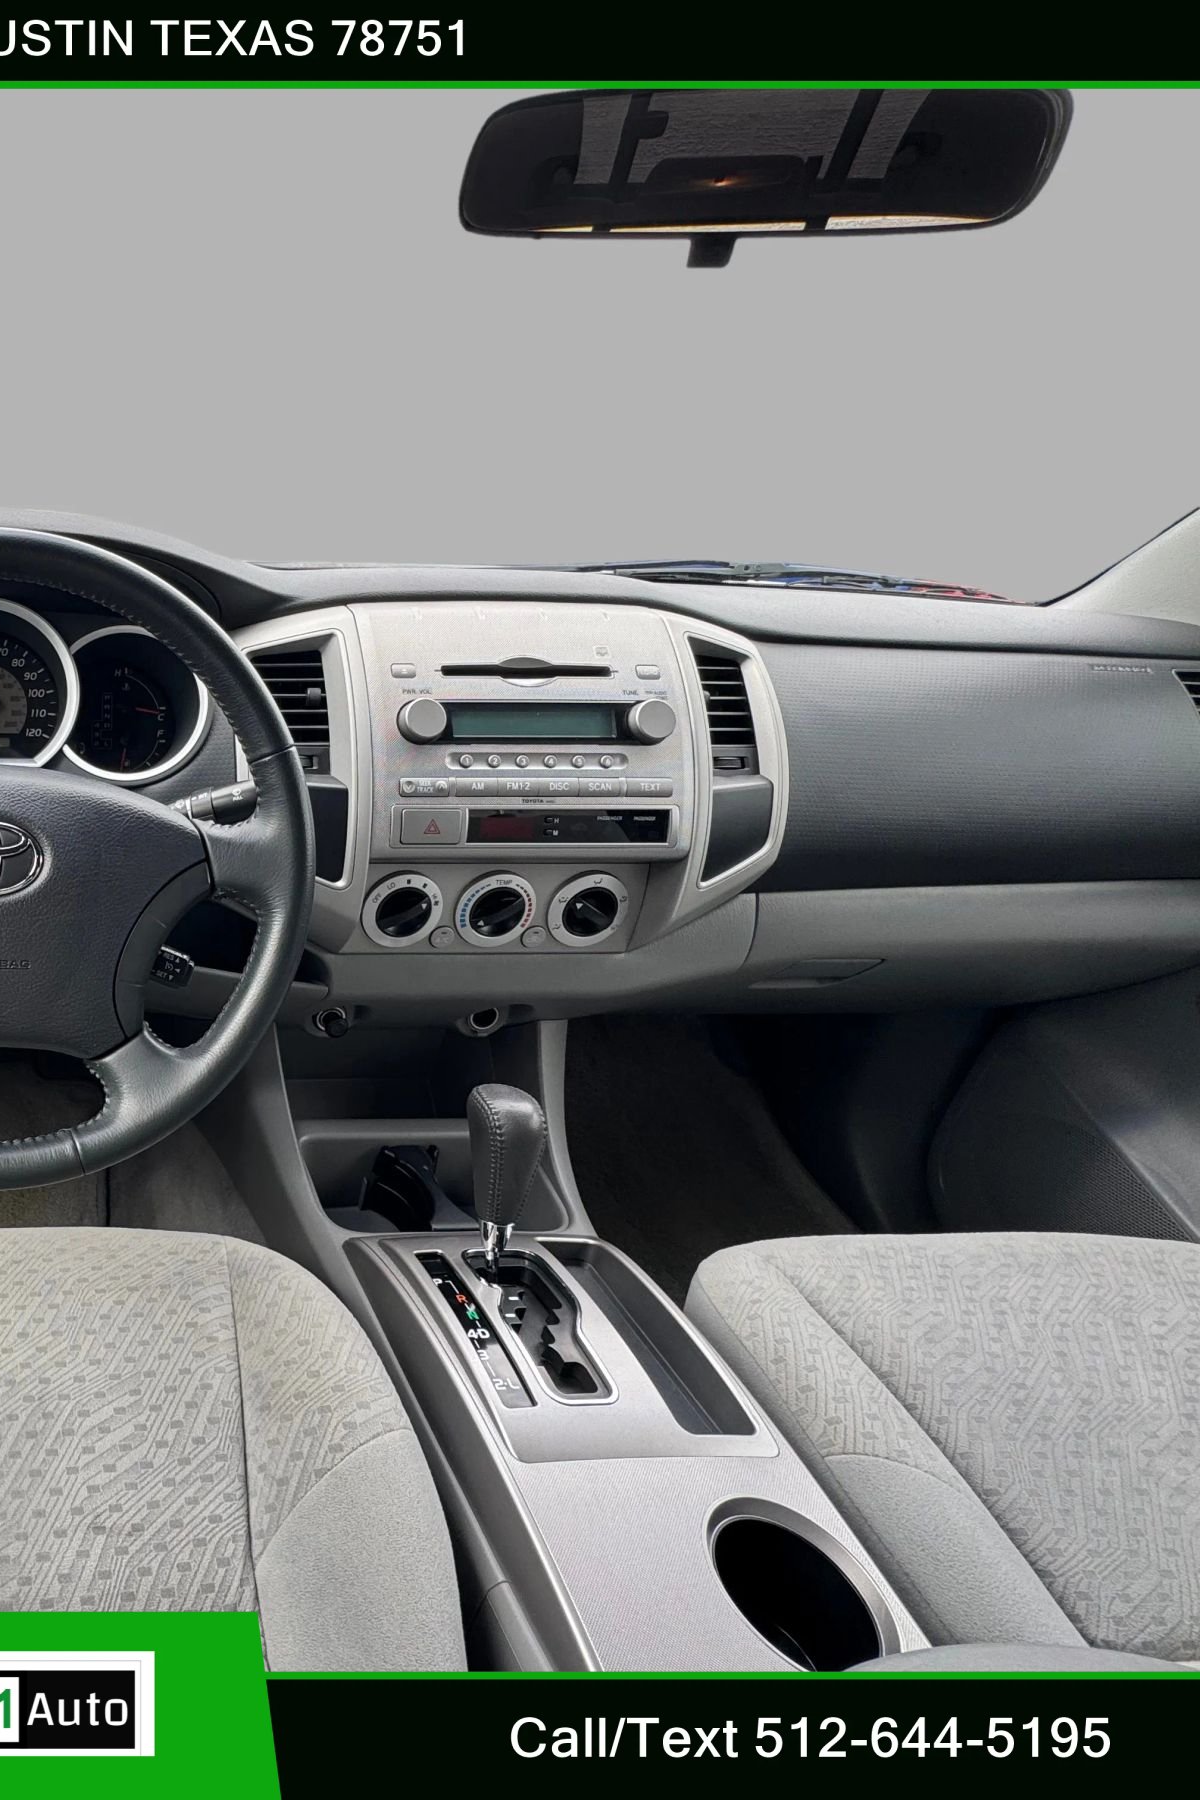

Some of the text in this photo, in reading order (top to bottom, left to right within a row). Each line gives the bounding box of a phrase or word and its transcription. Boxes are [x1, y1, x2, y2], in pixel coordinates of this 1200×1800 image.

[11, 658, 25, 667] 80
[23, 672, 38, 680] 90
[28, 689, 45, 698] 100
[31, 709, 47, 718] 110
[25, 728, 42, 737] 120
[471, 782, 484, 791] AM
[549, 783, 569, 791] DISC
[588, 783, 611, 791] SCAN
[640, 783, 661, 791] TEXT
[432, 1278, 443, 1287] P
[455, 1294, 468, 1303] R
[466, 1310, 479, 1320] N
[477, 1349, 489, 1360] 3
